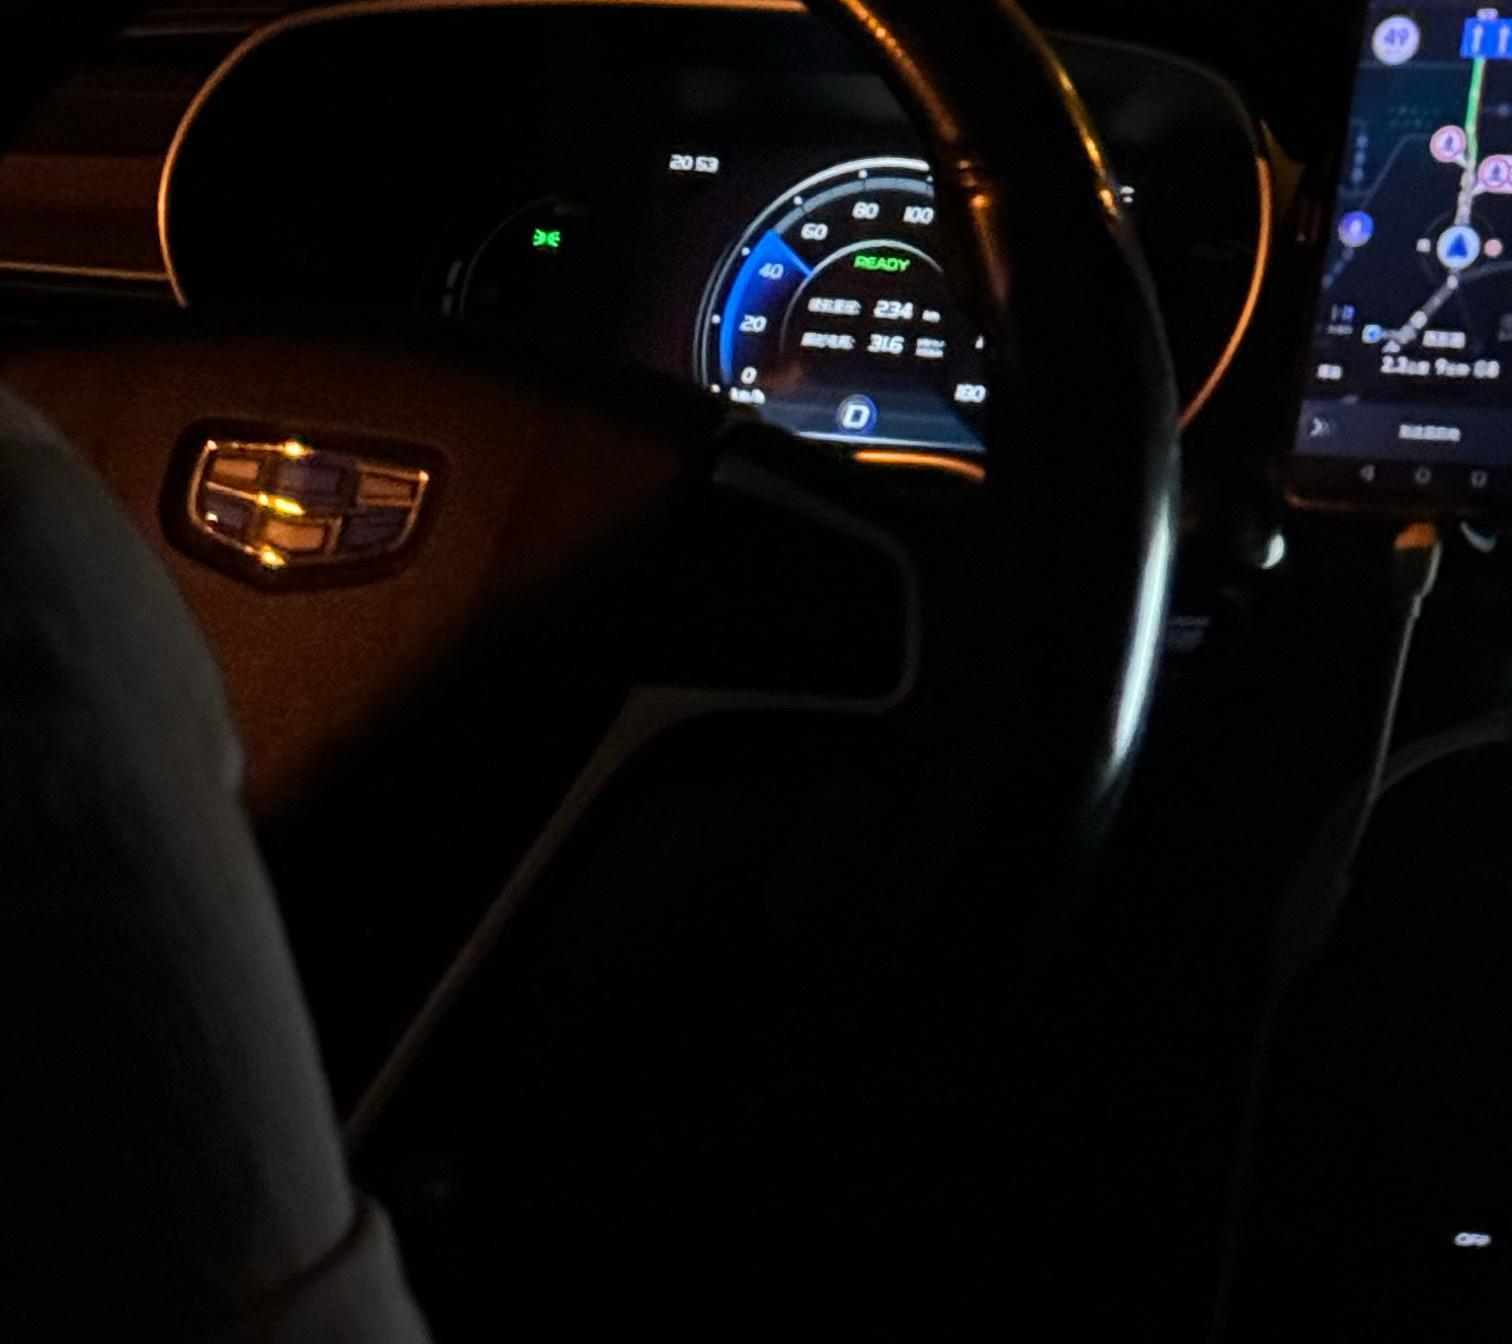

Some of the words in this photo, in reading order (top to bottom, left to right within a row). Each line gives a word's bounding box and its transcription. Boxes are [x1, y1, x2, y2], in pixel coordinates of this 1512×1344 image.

[852, 201, 880, 220] 80
[903, 205, 934, 225] 100
[800, 223, 828, 241] 60
[758, 262, 784, 280] 40
[854, 254, 910, 272] READY
[739, 314, 767, 333] 20
[740, 366, 757, 385] 0
[841, 403, 871, 429] D
